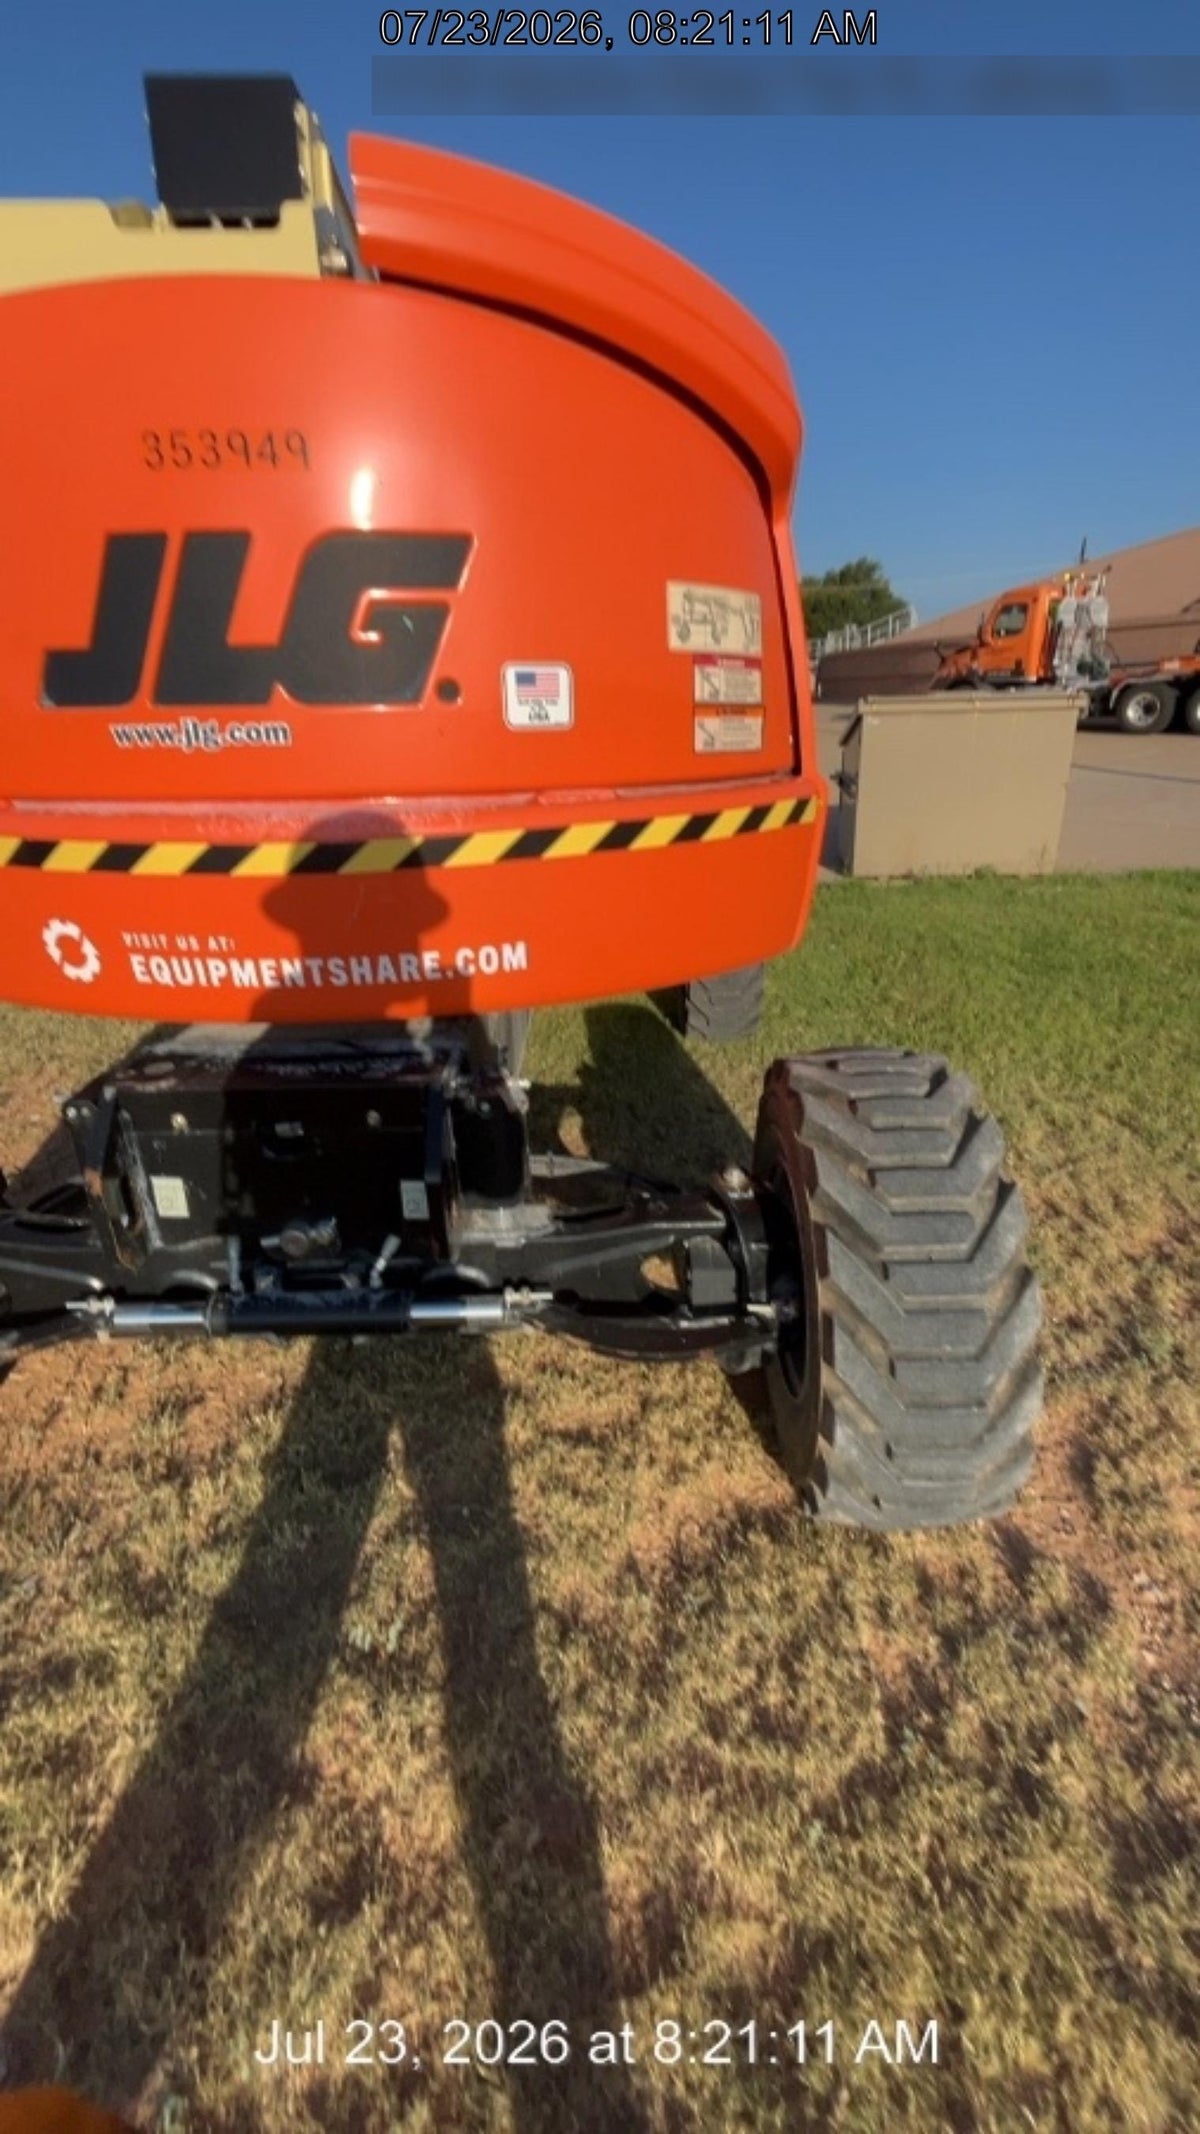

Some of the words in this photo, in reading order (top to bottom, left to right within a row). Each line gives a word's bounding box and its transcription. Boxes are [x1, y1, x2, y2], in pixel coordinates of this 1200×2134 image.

[142, 429, 311, 471] 353949
[109, 716, 292, 753] www.jlg.com
[121, 931, 168, 950] VISIT
[175, 934, 200, 951] US
[129, 941, 529, 988] EQUIPMENTSHARE.COM
